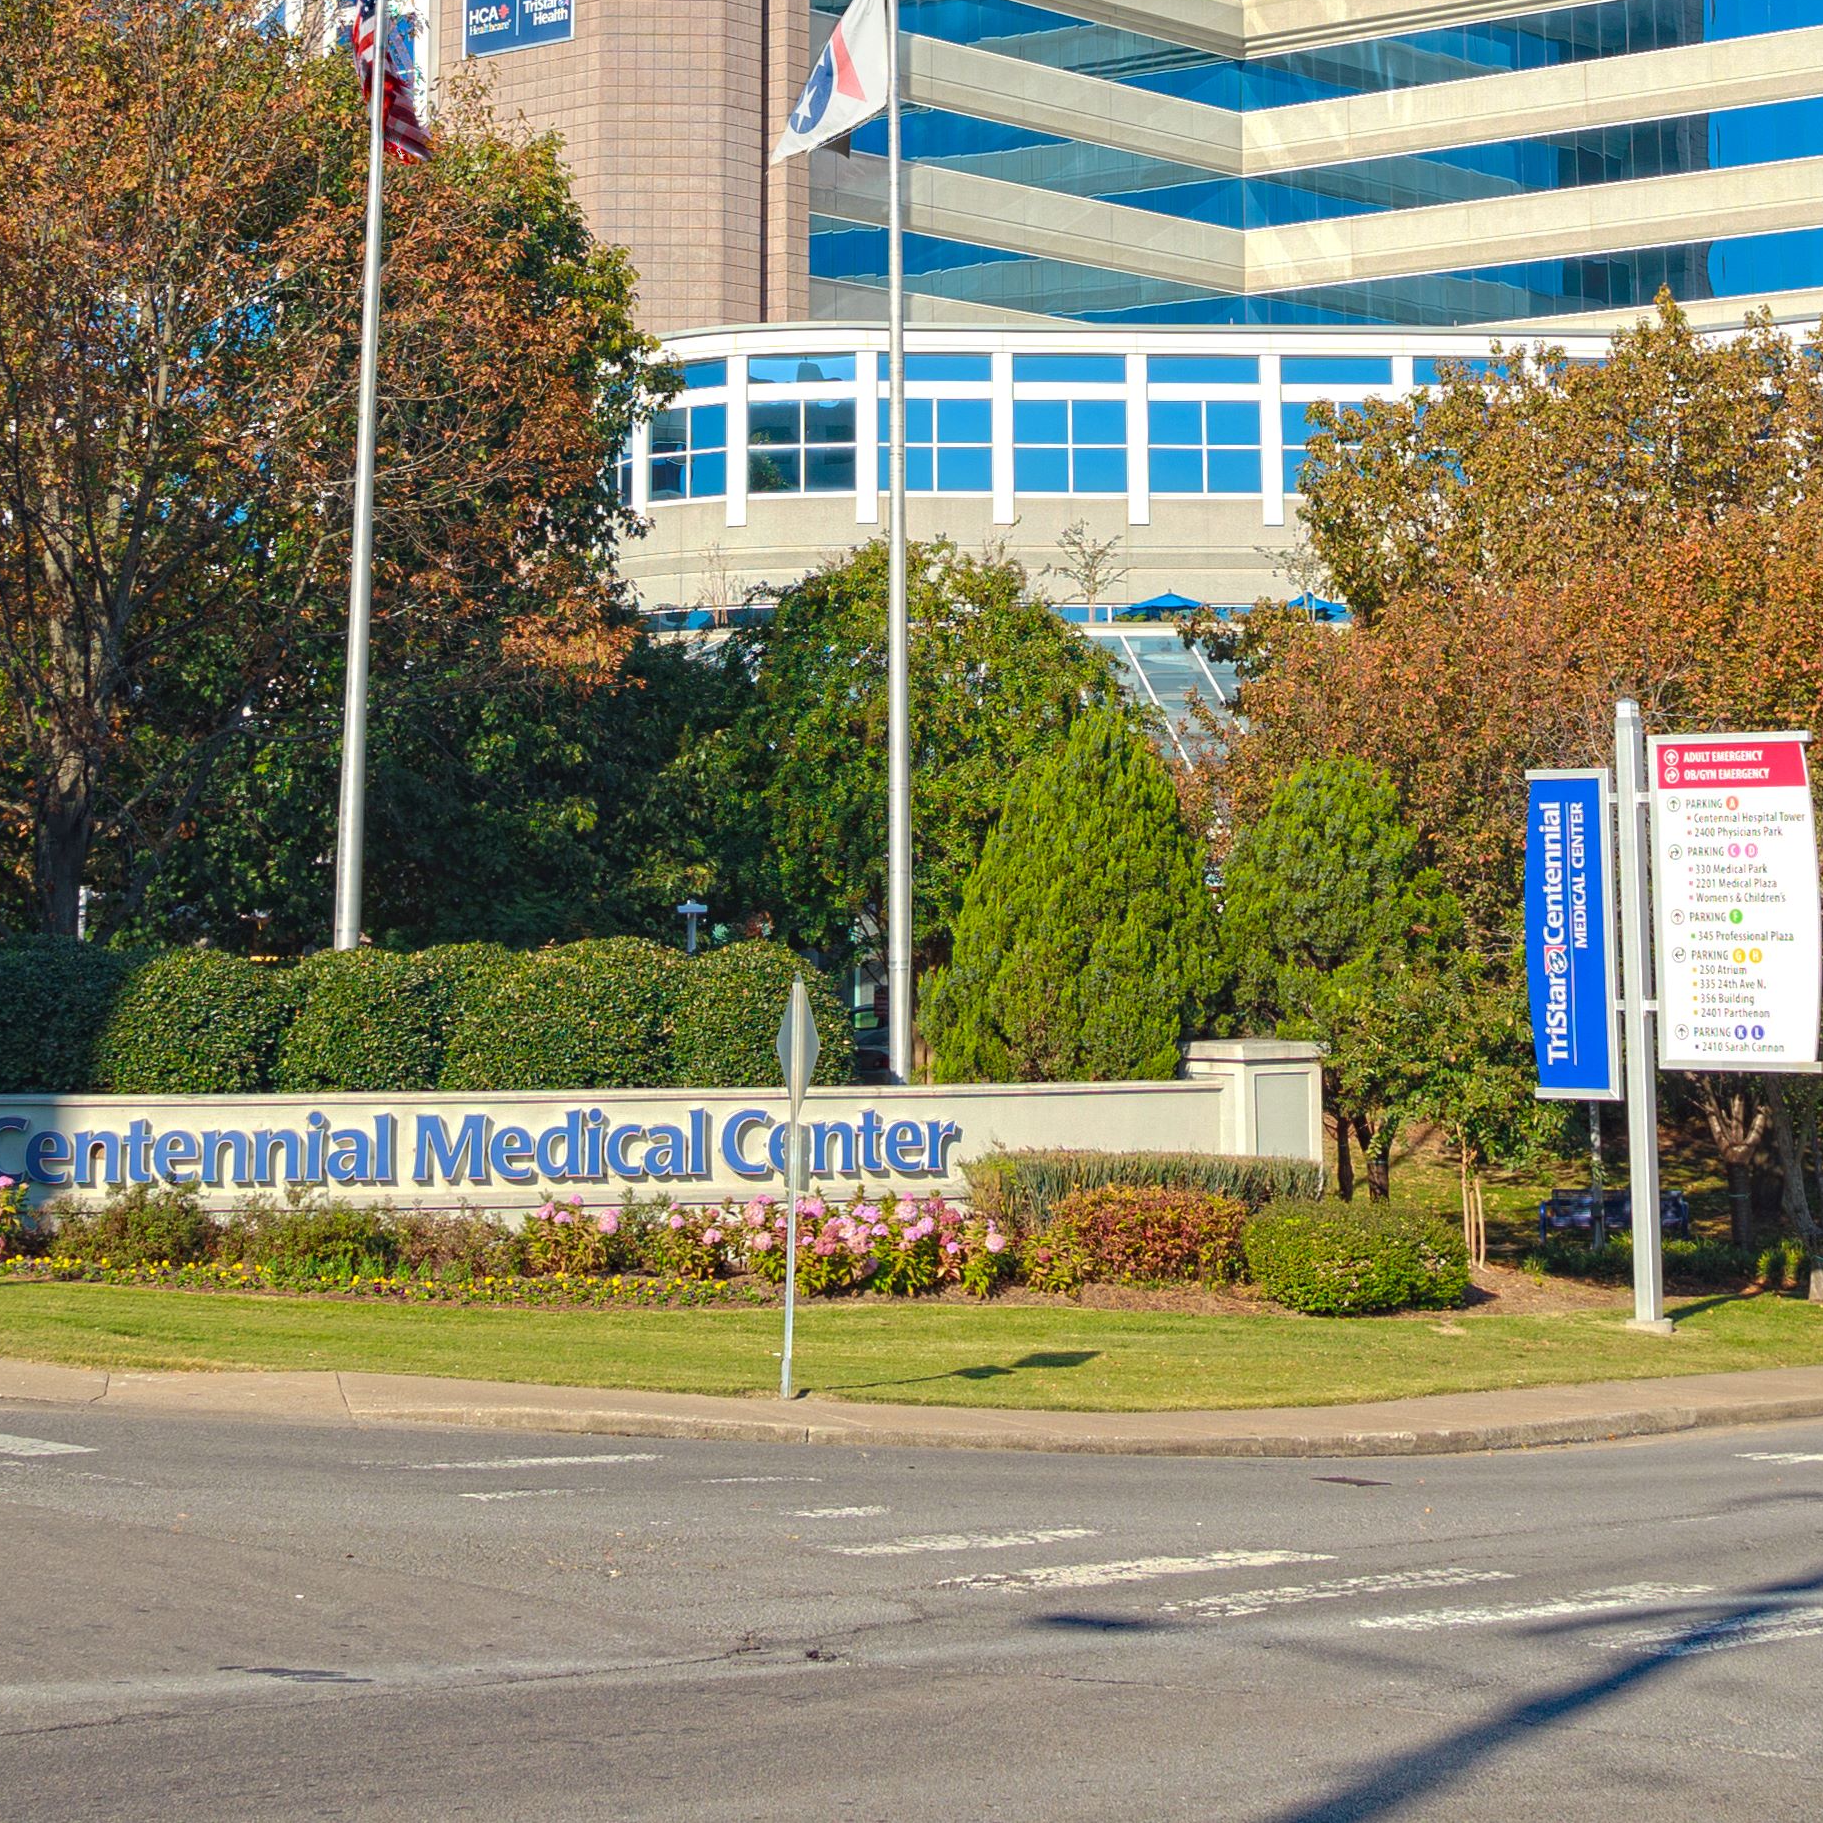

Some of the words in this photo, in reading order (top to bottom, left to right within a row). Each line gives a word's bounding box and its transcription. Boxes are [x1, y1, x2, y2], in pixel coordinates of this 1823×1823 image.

[469, 6, 499, 25] HCA
[533, 7, 569, 26] Health
[1683, 751, 1710, 763] ADULT
[1712, 750, 1763, 762] EMERGENCY
[1684, 769, 1717, 781] OB/GYN
[1718, 768, 1770, 780] EMERGENCY
[1685, 799, 1723, 809] PARKING
[1693, 813, 1740, 823] Centennial
[1742, 812, 1777, 824] Hospital
[1779, 812, 1805, 822] Tower
[1569, 801, 1586, 870] CENTER
[1694, 828, 1715, 837] 2400
[1717, 827, 1761, 839] Physicians
[1763, 826, 1783, 836] Park
[1687, 846, 1724, 856] PARKING
[1539, 801, 1565, 946] Centennial
[1695, 864, 1711, 874] 330
[1713, 864, 1746, 874] Medical
[1748, 863, 1767, 873] Park
[1695, 879, 1716, 888] 2201
[1719, 878, 1751, 888] Medical
[1754, 878, 1777, 888] Plaza
[1696, 893, 1734, 903] Women's
[1735, 893, 1742, 902] &
[1744, 892, 1786, 902] Children's
[1573, 872, 1589, 949] MEDICAL
[1689, 912, 1726, 922] PARKING
[1698, 931, 1714, 941] 345
[1716, 931, 1768, 941] Professional
[1771, 931, 1794, 941] Plaza
[1691, 950, 1729, 960] PARKING
[1699, 965, 1716, 974] 250
[1717, 965, 1747, 974] Atrium
[1700, 979, 1716, 989] 335
[1718, 979, 1737, 988] 24th
[1739, 979, 1755, 989] Ave
[1757, 979, 1766, 989] N.
[1700, 993, 1716, 1003] 356
[1718, 993, 1754, 1005] Building
[1701, 1008, 1721, 1018] 2401
[1724, 1007, 1770, 1017] Parthenon
[1545, 973, 1569, 1066] TriStar
[1693, 1027, 1731, 1037] PARKING
[1702, 1042, 1723, 1052] 2410
[1725, 1042, 1750, 1052] Sarah
[1752, 1042, 1785, 1052] Cannon
[412, 1107, 707, 1182] Medical
